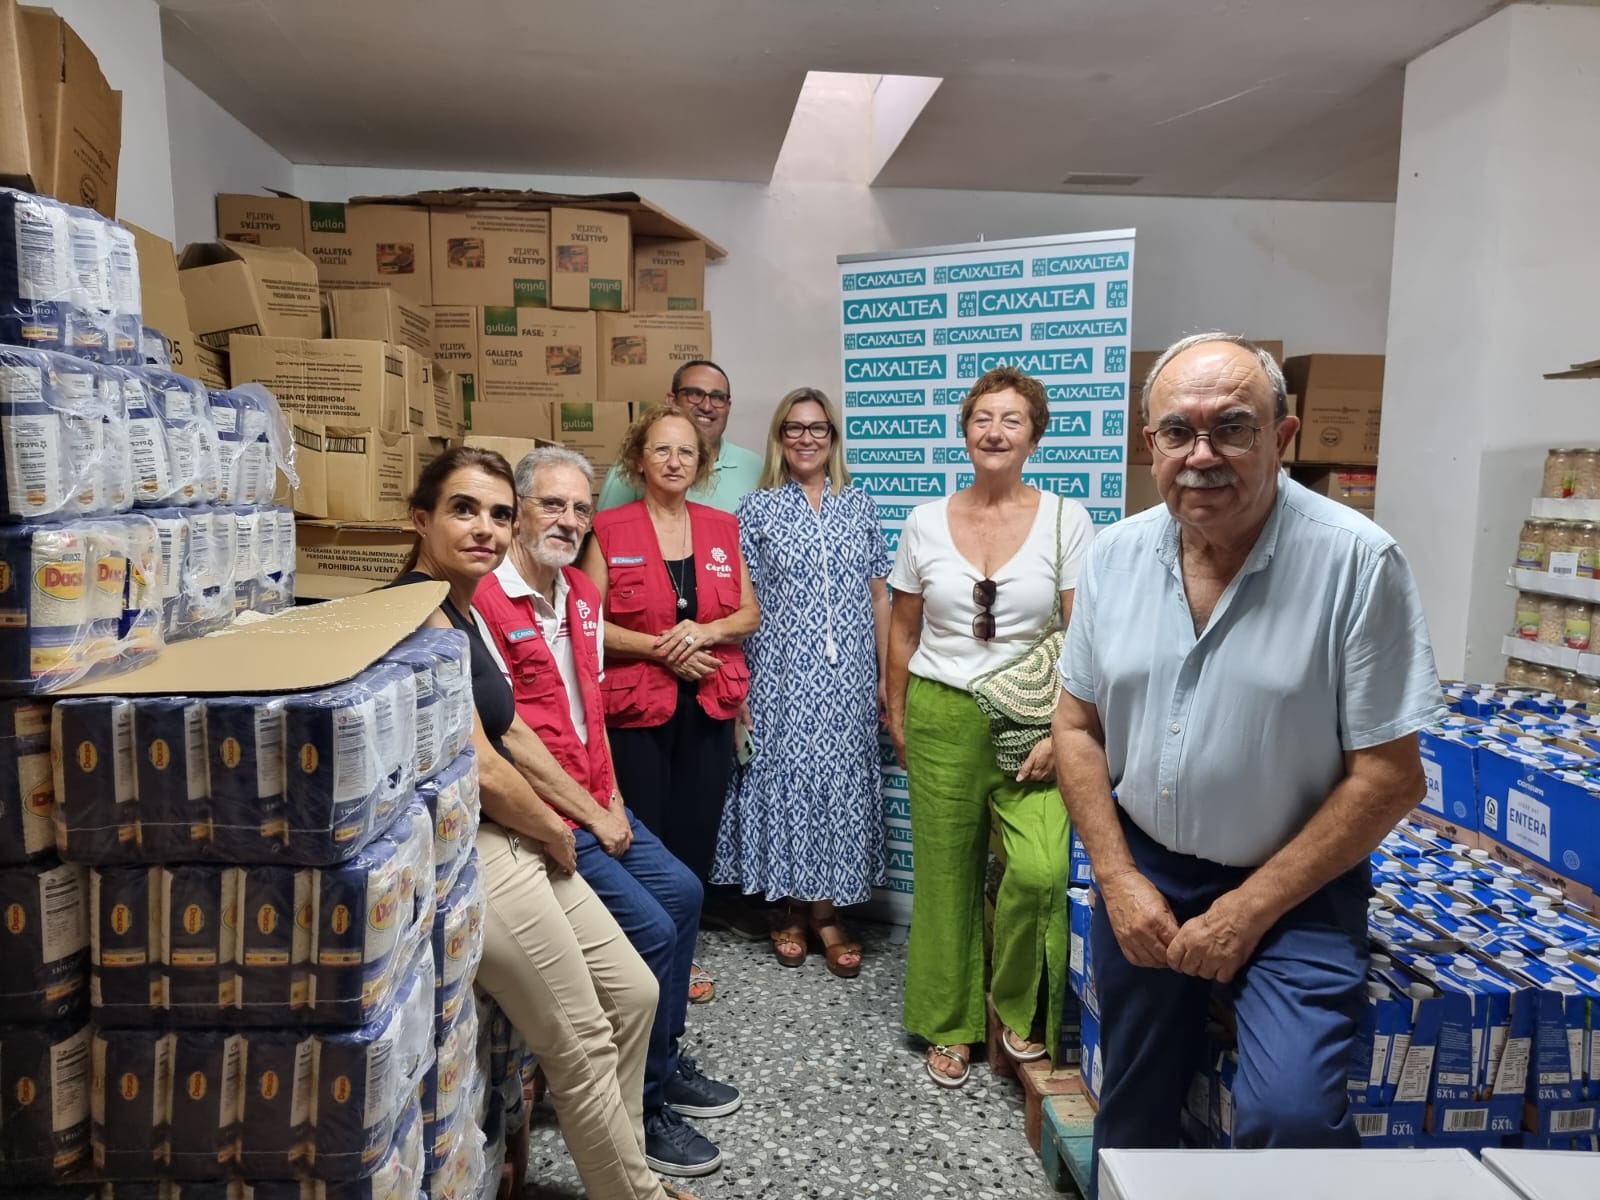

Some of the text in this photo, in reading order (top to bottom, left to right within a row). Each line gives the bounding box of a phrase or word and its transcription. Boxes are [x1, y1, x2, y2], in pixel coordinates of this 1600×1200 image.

[312, 247, 353, 256] GALLETAS
[1050, 255, 1125, 273] CAIXALTEA
[858, 272, 924, 287] CAIXALTEA
[950, 264, 1020, 280] CAIXALTEA
[982, 289, 1090, 312] CAIXALTEA
[847, 299, 943, 320] CAIXALTEA
[521, 328, 545, 337] FASE:
[950, 327, 1020, 343] CAIXALTEA
[1048, 321, 1124, 337] CAIXALTEA
[859, 333, 923, 346] CAIXALTEA
[485, 349, 523, 358] GALLETAS
[848, 360, 942, 378] CAIXALTEA
[981, 353, 1088, 373] CAIXALTEA
[859, 392, 923, 404] CAIXALTEA
[1047, 386, 1122, 399] CAIXALTEA
[849, 419, 942, 435] CAIXALTEA
[860, 451, 922, 462] CAIXALTEA
[1045, 449, 1120, 460] CAIXALTEA
[318, 562, 360, 572] PROHIBIDA
[374, 566, 400, 574] VENTA
[1509, 807, 1547, 839] ENTERA
